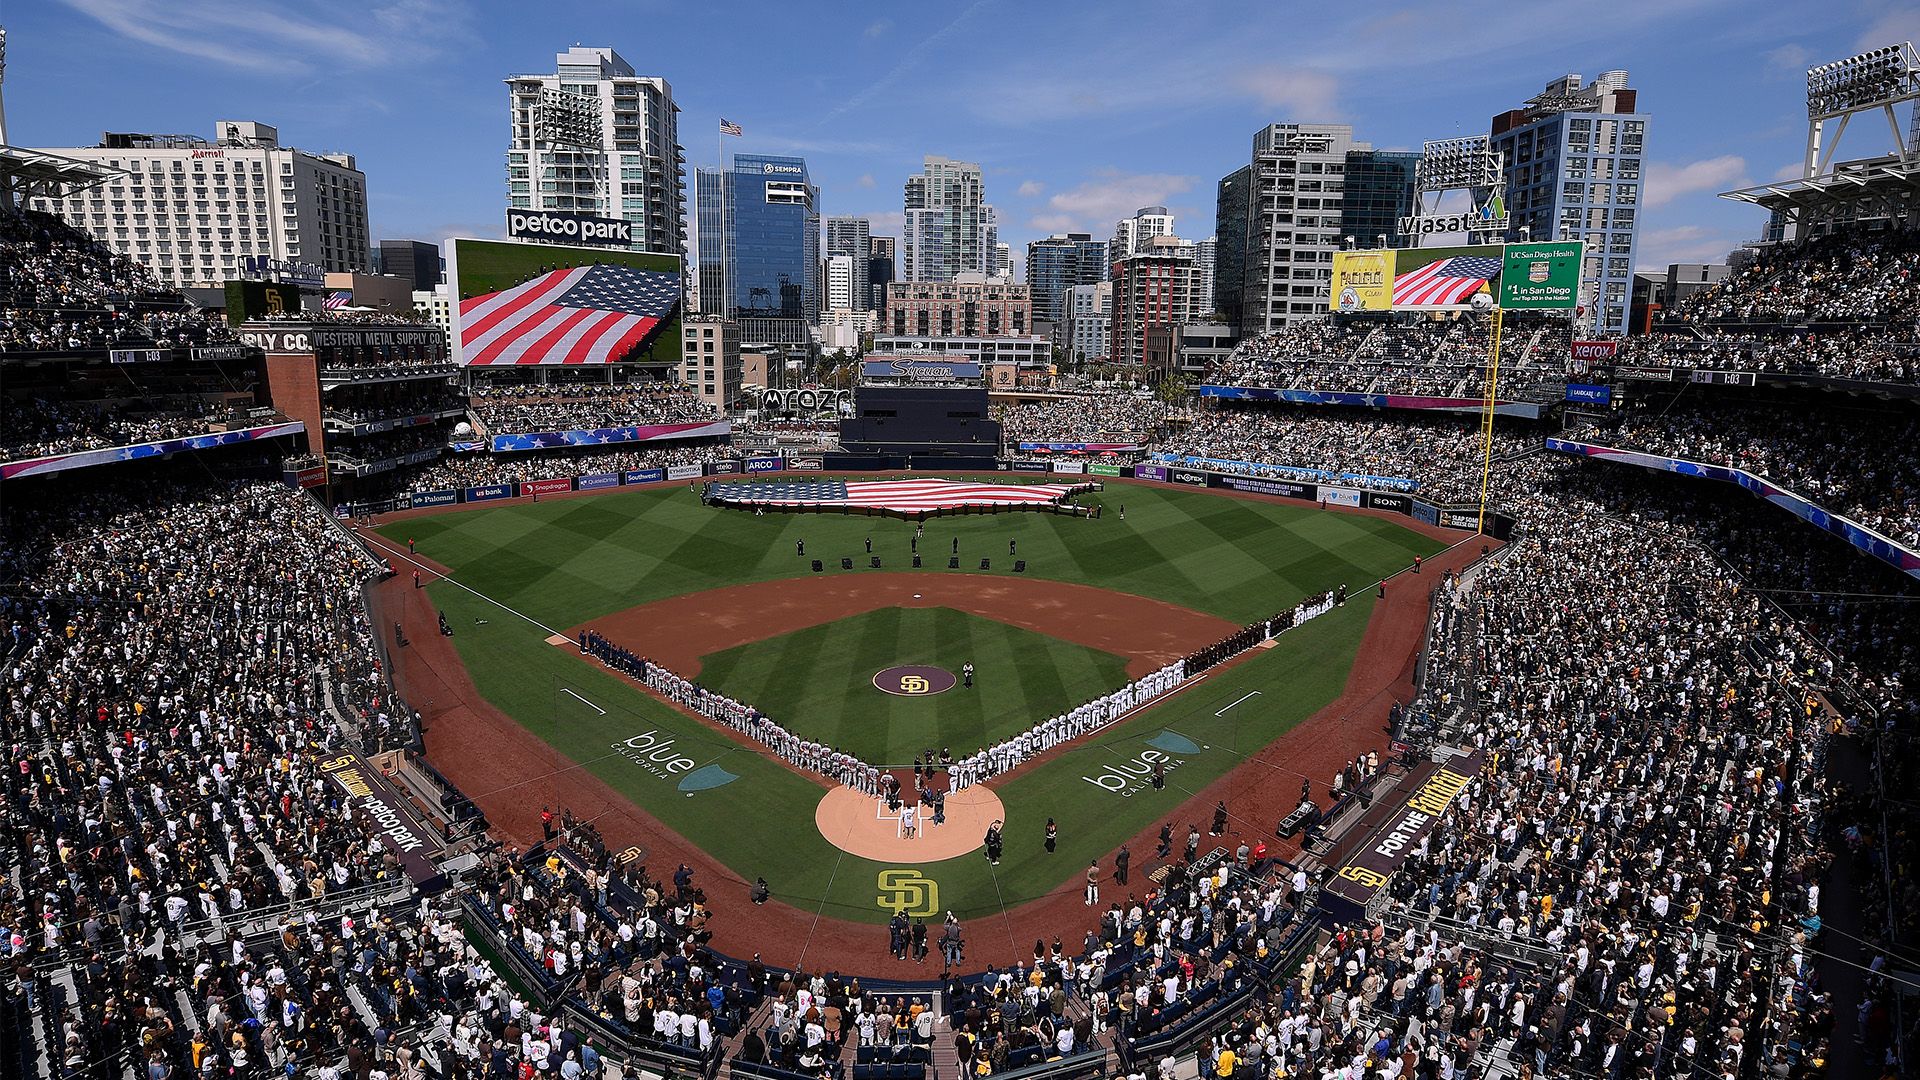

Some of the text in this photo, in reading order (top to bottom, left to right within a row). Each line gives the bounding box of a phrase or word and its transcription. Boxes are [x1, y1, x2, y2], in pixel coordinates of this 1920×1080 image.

[192, 150, 225, 159] Marriott
[510, 213, 631, 242] petco park
[1400, 213, 1472, 235] Viasat
[1534, 251, 1552, 259] Diego
[1553, 250, 1575, 258] Health
[1547, 286, 1571, 295] Diego
[283, 333, 313, 351] CO.
[314, 332, 443, 346] WESTERN METAL SUPPLY CO.
[145, 351, 161, 361] 1:03
[1575, 345, 1610, 358] xerox
[889, 358, 953, 381] Sycuan
[1724, 373, 1740, 384] 1:03
[785, 389, 850, 411] razr
[715, 463, 733, 471] stelo
[748, 461, 773, 469] ARCO
[789, 458, 820, 470] Sycuan
[627, 473, 656, 481] Southwest
[485, 488, 503, 496] bank
[535, 483, 569, 492] Snapdragon
[396, 500, 409, 509] 342
[424, 495, 455, 503] Palomar
[901, 675, 929, 693] SD
[622, 730, 695, 774] blue
[610, 743, 669, 781] CALIFORNIA
[1082, 750, 1170, 793] blue
[359, 800, 425, 853] petco park
[1374, 810, 1430, 858] FOR THE
[877, 869, 939, 917] SD
[923, 1016, 931, 1024] 19
